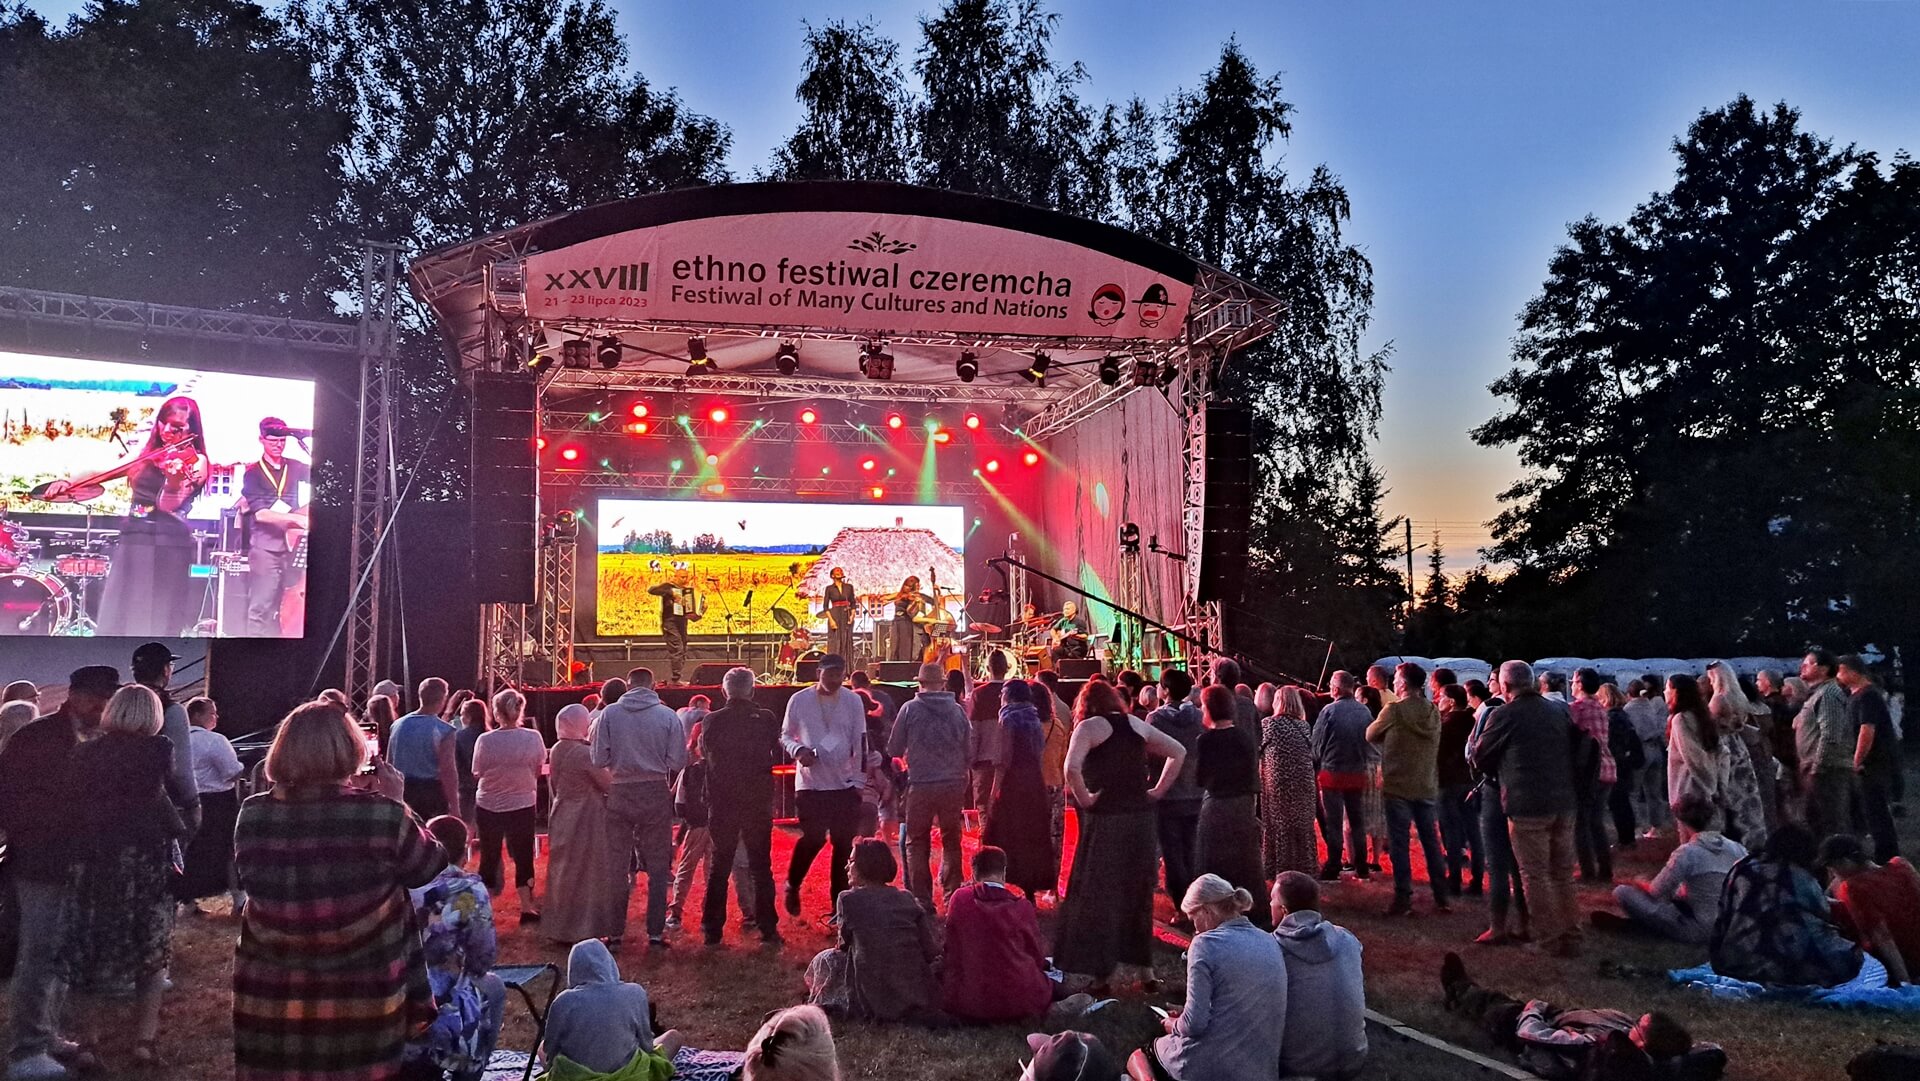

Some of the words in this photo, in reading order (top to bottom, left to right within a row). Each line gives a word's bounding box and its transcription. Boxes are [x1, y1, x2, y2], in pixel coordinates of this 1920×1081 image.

[672, 255, 767, 284] ethno
[777, 258, 899, 289] festiwal
[909, 270, 1072, 298] czeremcha
[544, 297, 559, 307] 21
[570, 295, 585, 305] 23
[587, 295, 616, 308] lipca
[619, 296, 648, 308] 2023
[671, 285, 763, 306] Festiwal
[768, 287, 793, 307] of
[796, 289, 856, 314] Many
[860, 292, 946, 314] Cultures
[950, 297, 989, 315] and
[993, 299, 1068, 320] Nations
